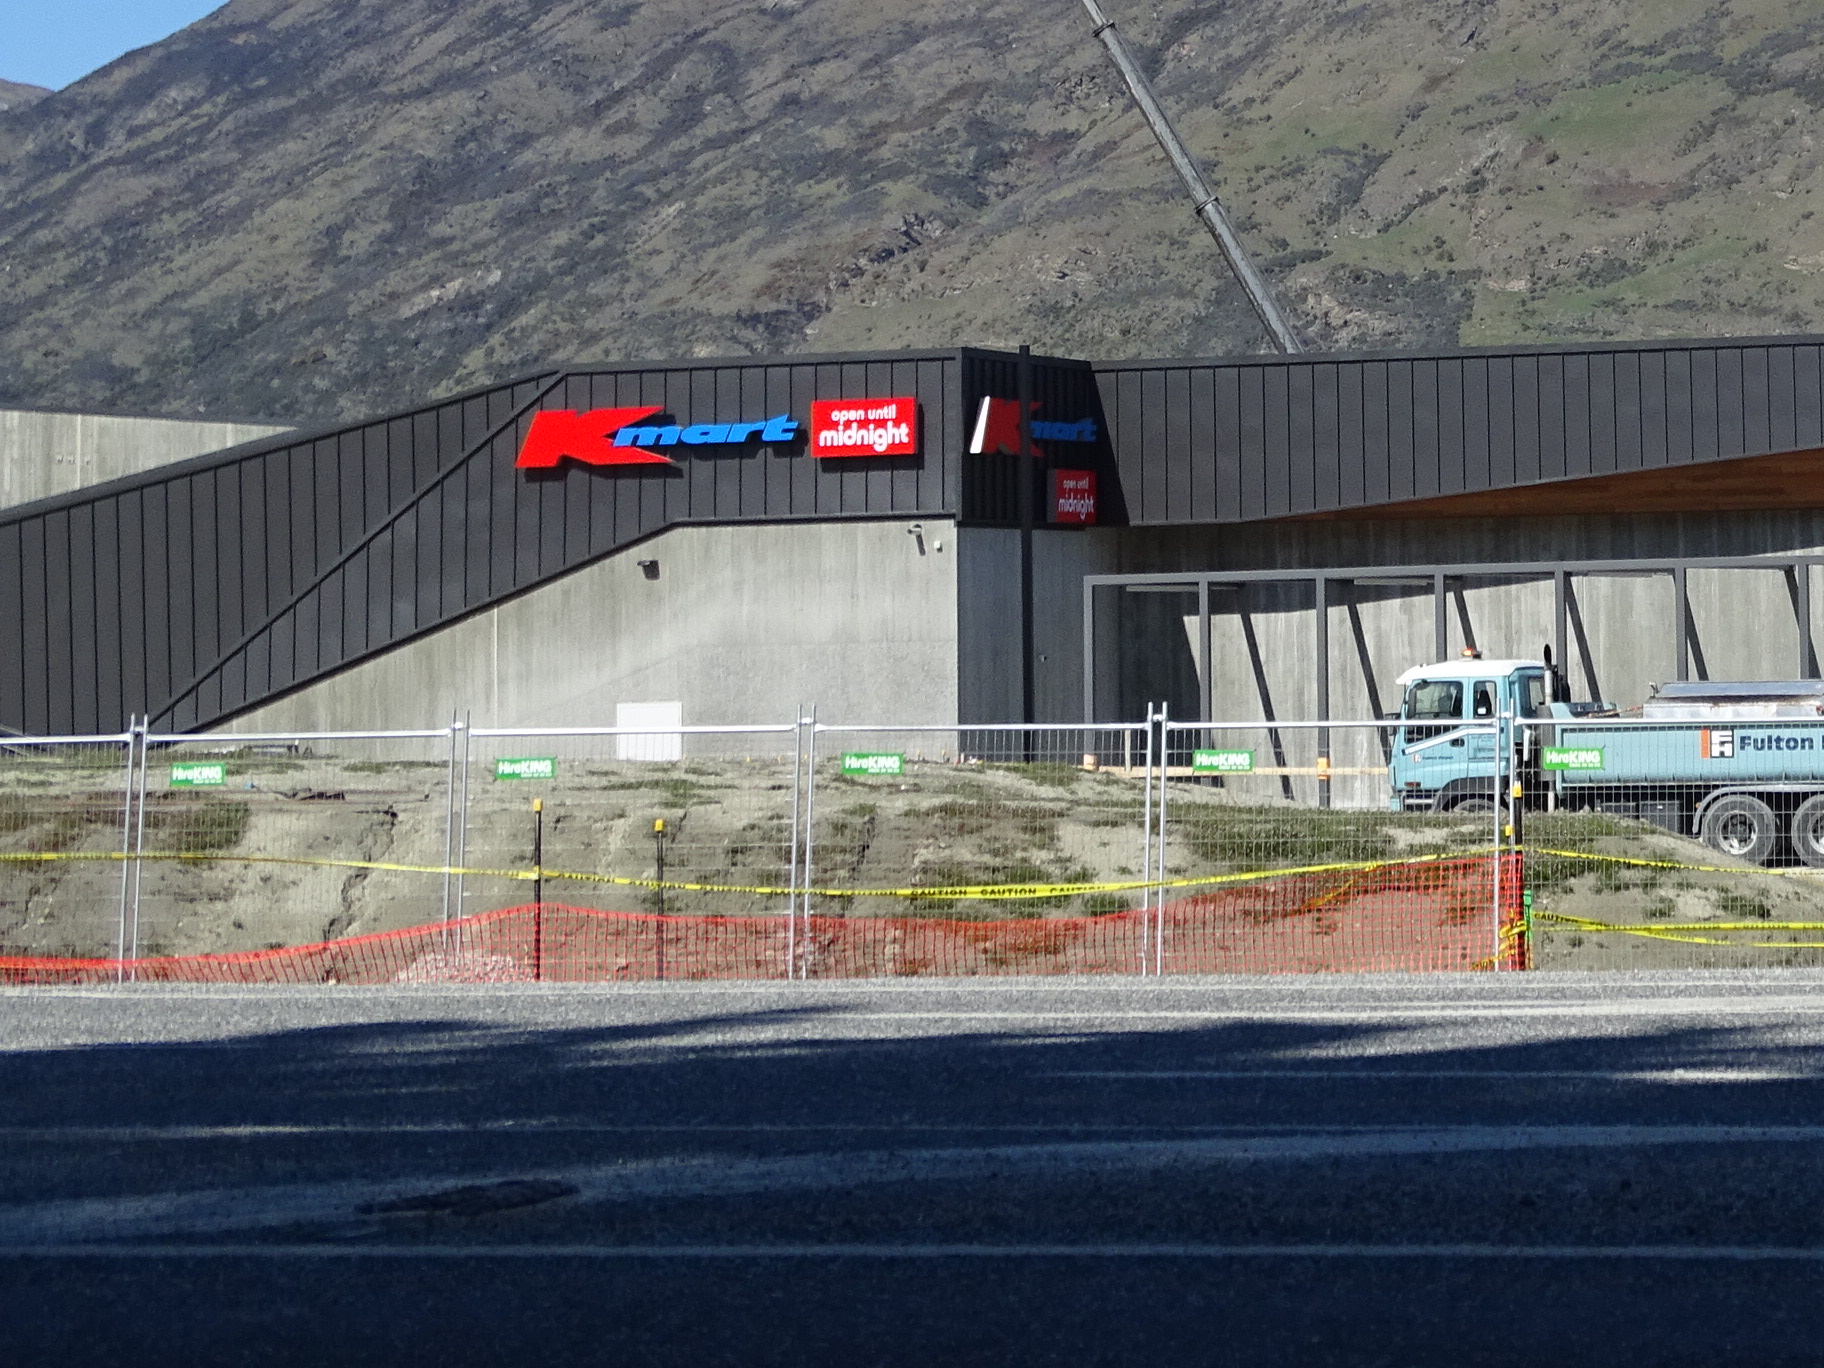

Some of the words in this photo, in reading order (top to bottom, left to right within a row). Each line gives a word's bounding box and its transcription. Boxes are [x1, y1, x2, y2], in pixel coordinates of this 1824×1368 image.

[831, 410, 865, 425] open
[868, 404, 897, 419] until
[515, 406, 798, 468] Kmart
[819, 420, 909, 452] midnight
[1058, 492, 1094, 520] midnight
[1739, 735, 1814, 751] Fulton
[980, 887, 1037, 896] CAUTION
